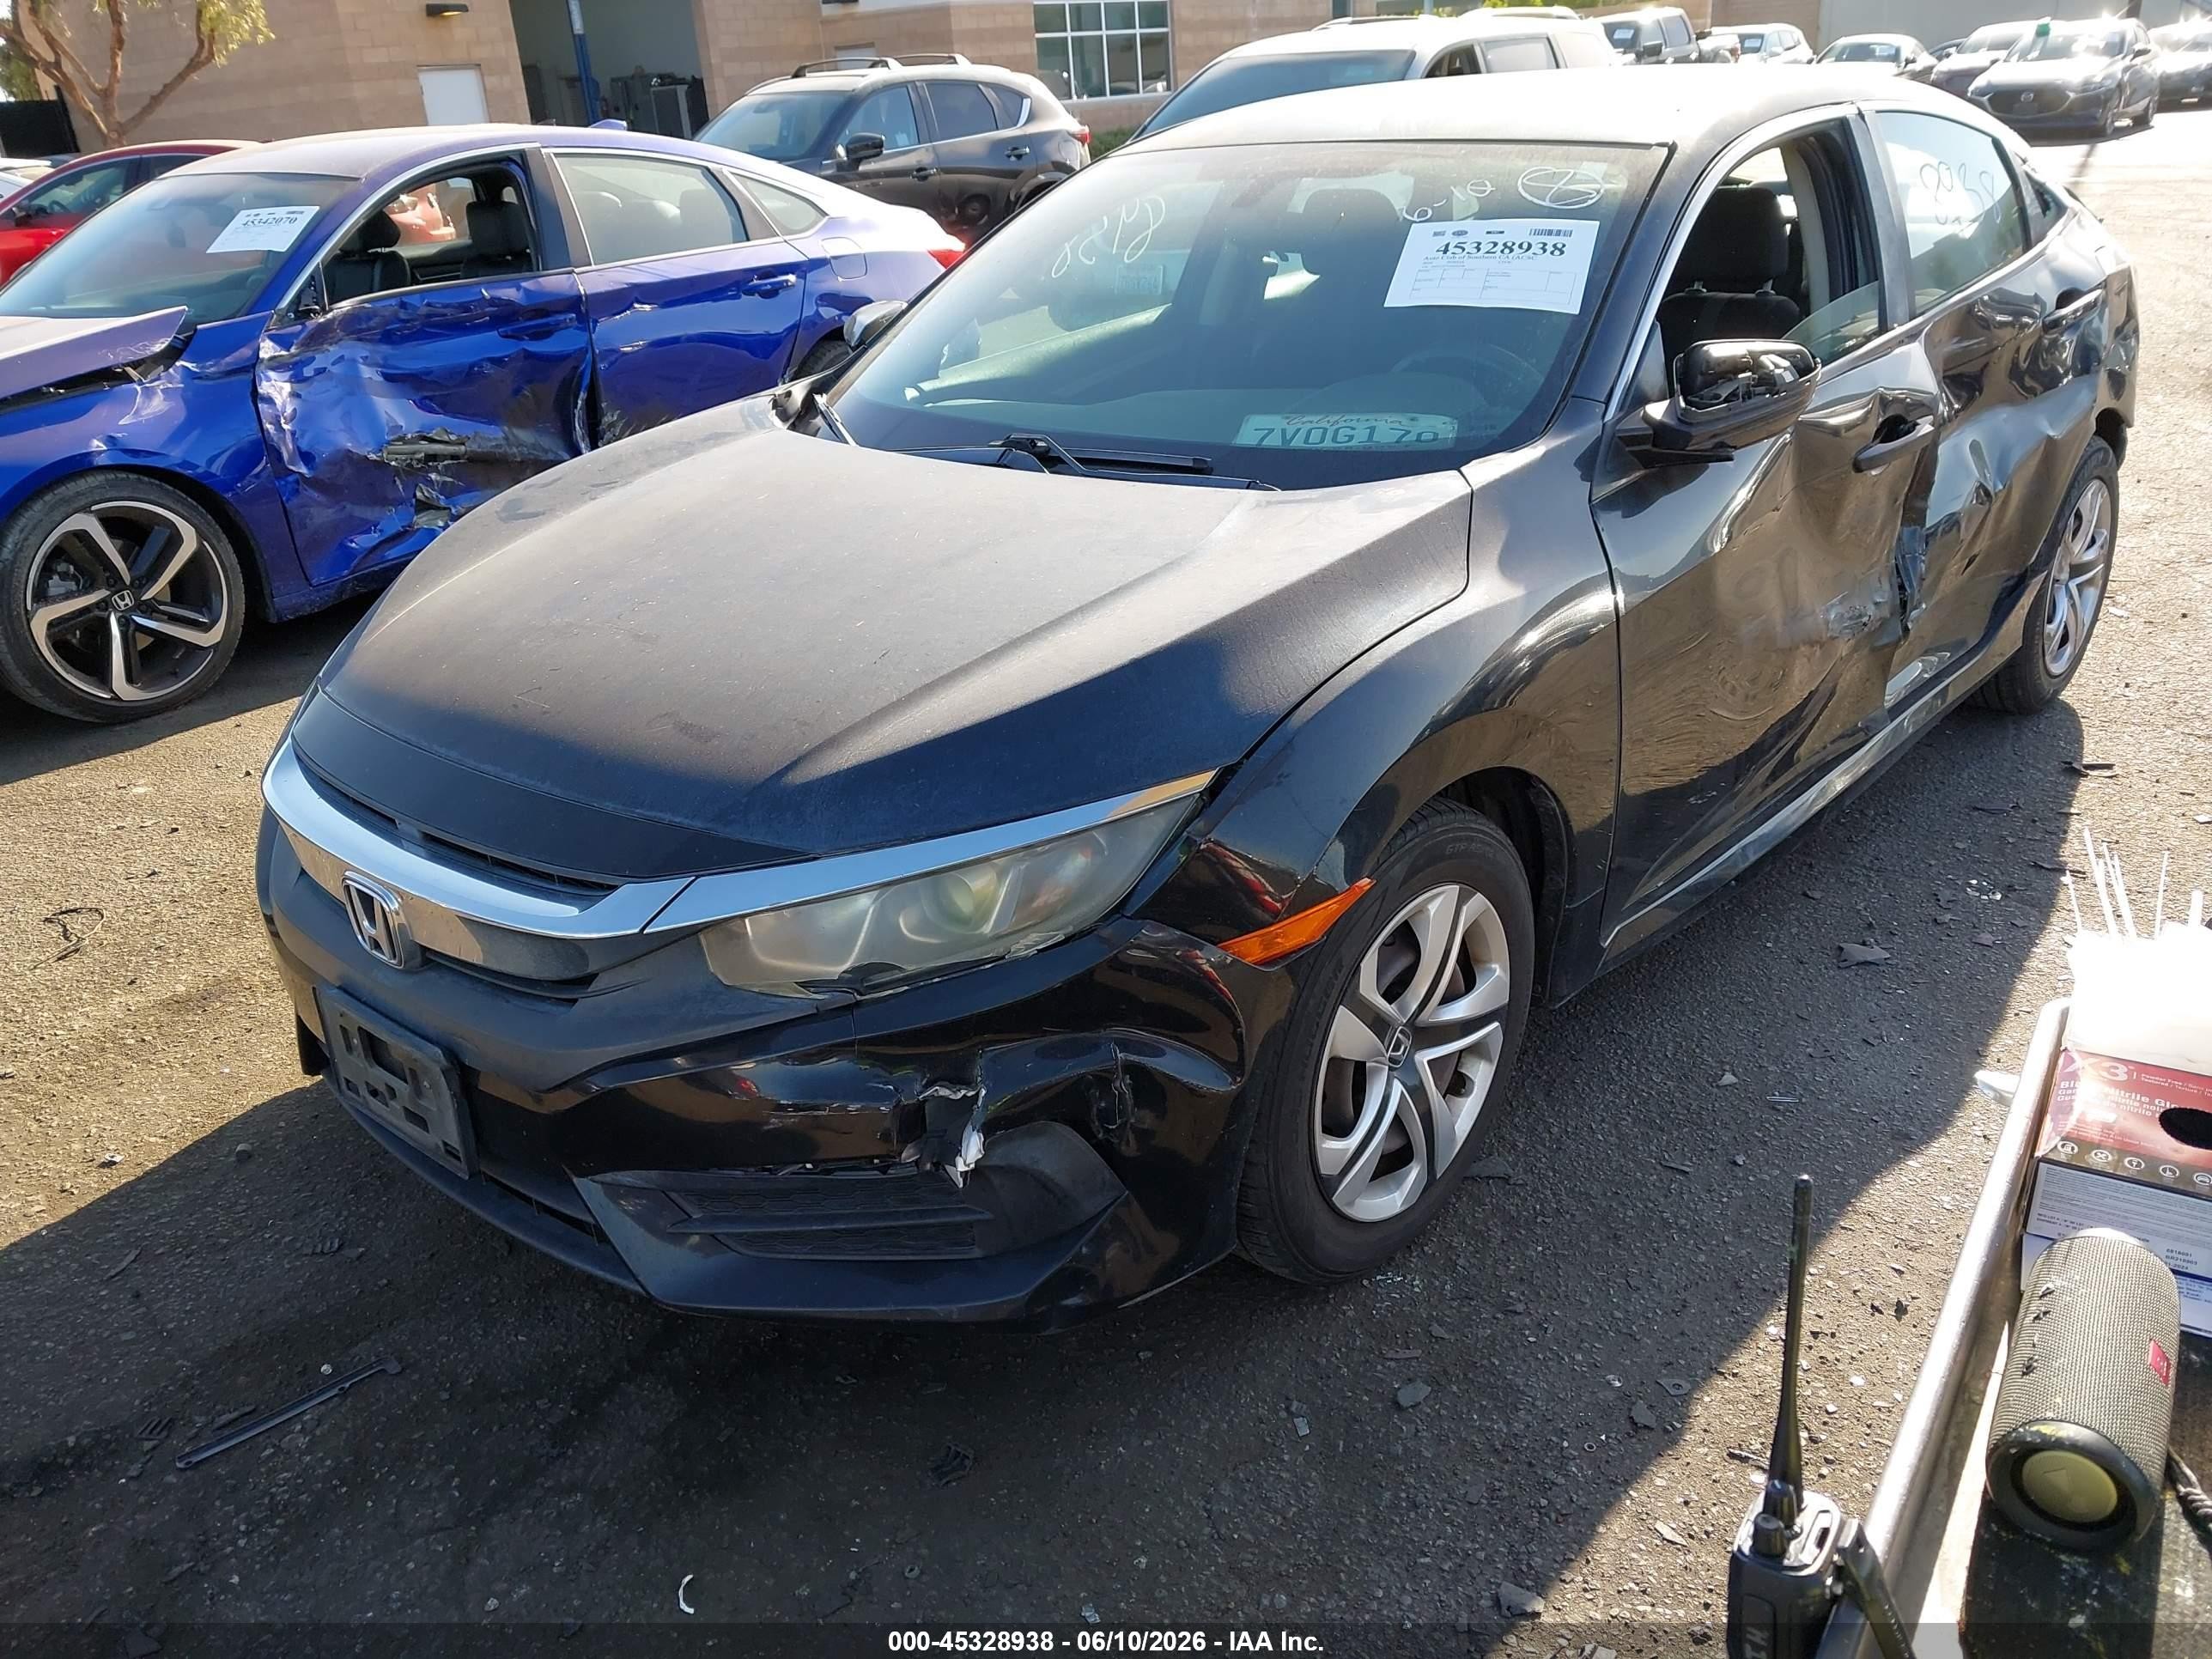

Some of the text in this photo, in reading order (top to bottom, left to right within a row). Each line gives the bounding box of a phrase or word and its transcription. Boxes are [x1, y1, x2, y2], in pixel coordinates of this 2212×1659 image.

[242, 216, 298, 227] 45342070
[1436, 240, 1567, 257] 45328938
[1284, 414, 1404, 427] California
